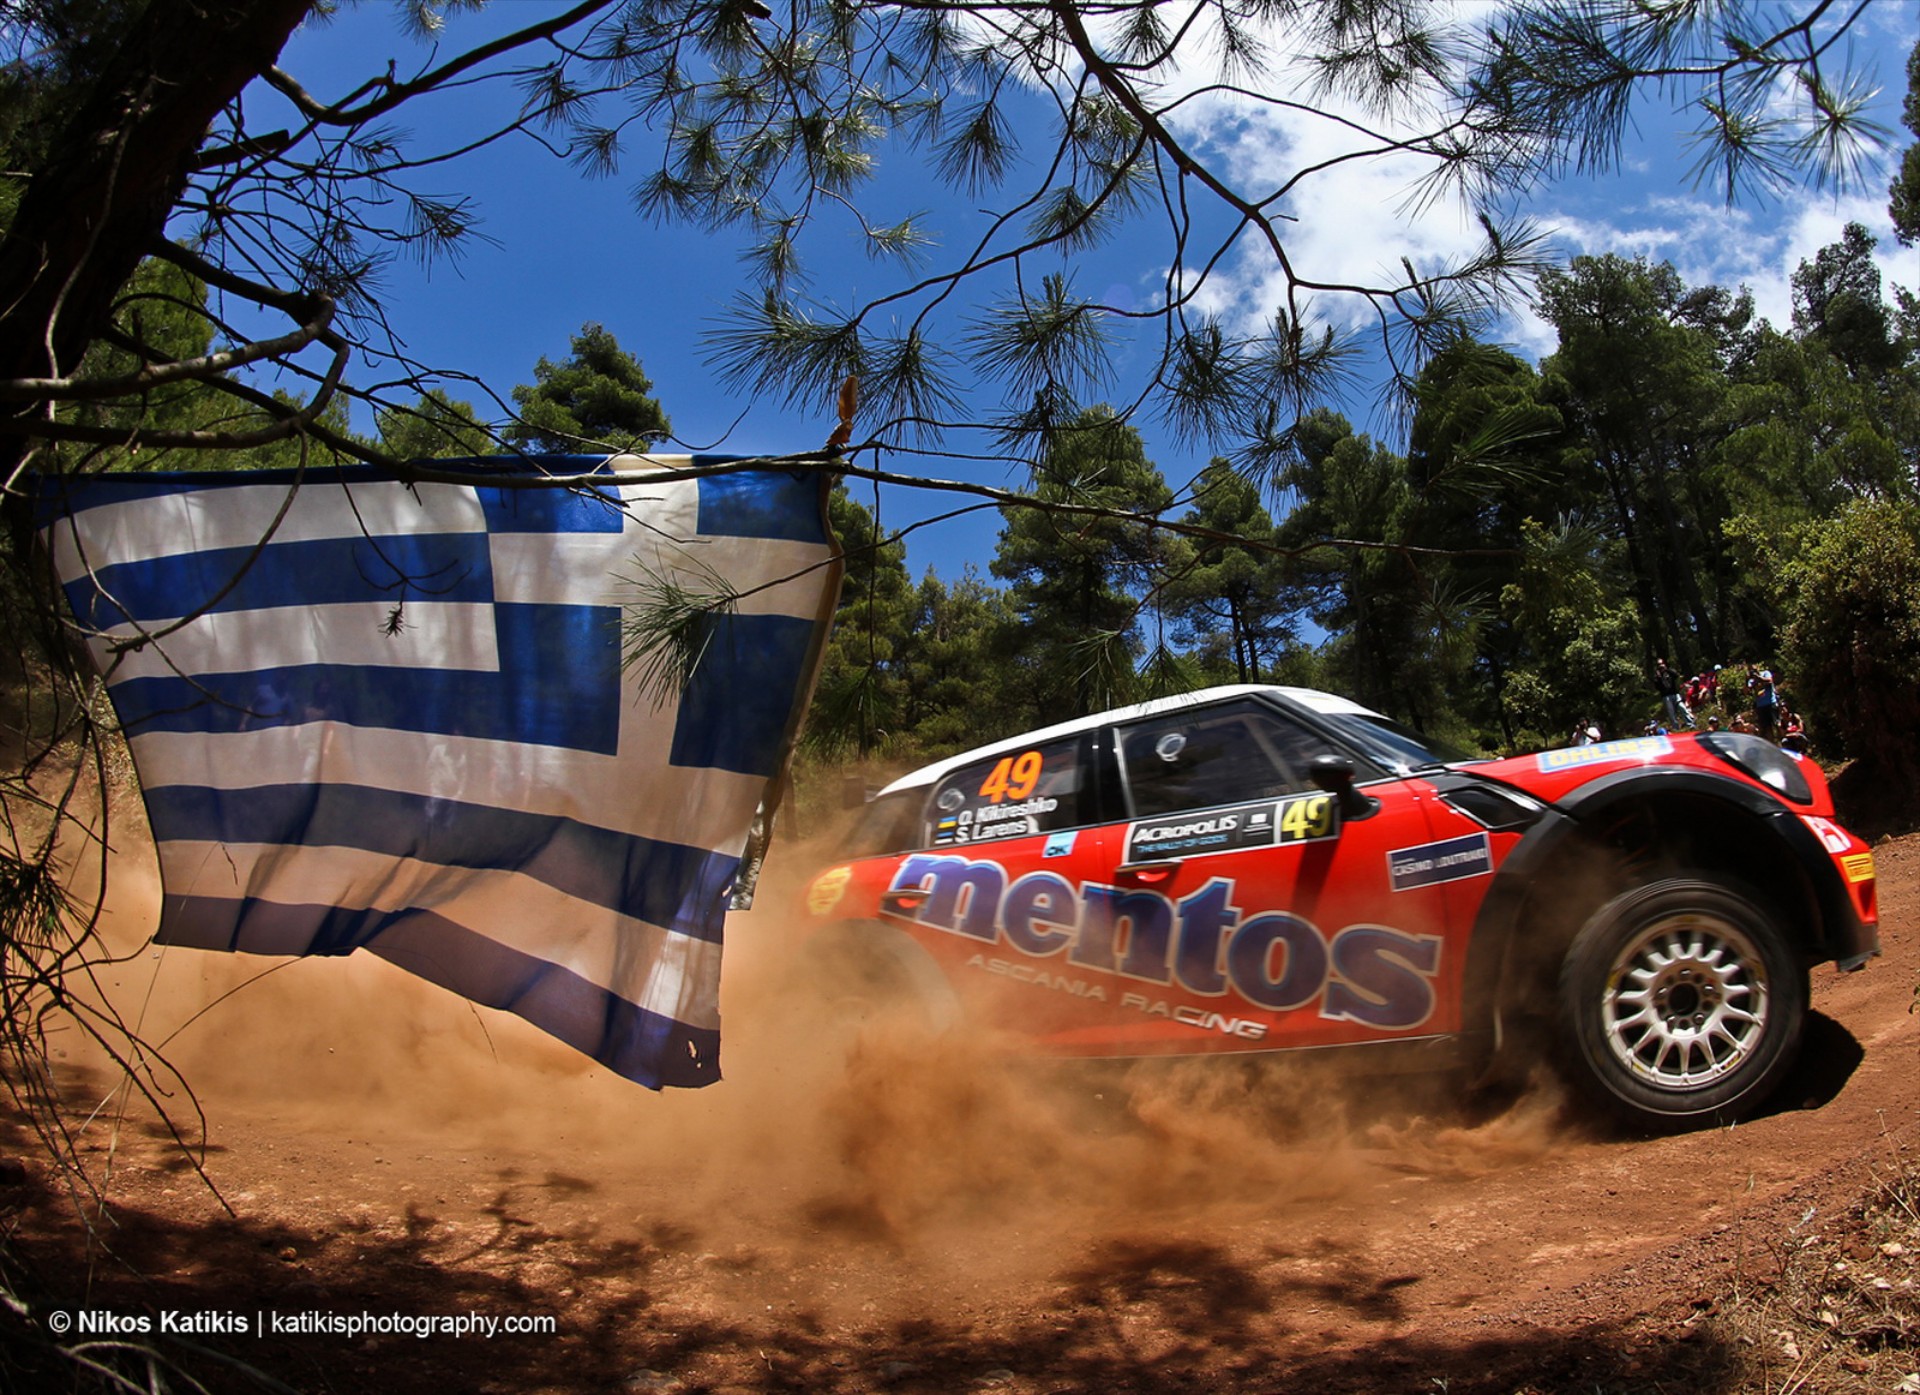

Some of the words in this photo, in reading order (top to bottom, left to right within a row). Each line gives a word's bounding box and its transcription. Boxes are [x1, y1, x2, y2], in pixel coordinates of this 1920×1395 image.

[979, 750, 1043, 803] 49
[1132, 814, 1238, 843] ACROPOLIS
[1281, 797, 1330, 839] 49
[879, 853, 1442, 1030] mentos
[966, 954, 1106, 1002] ASCANIA
[1121, 992, 1269, 1040] RACING
